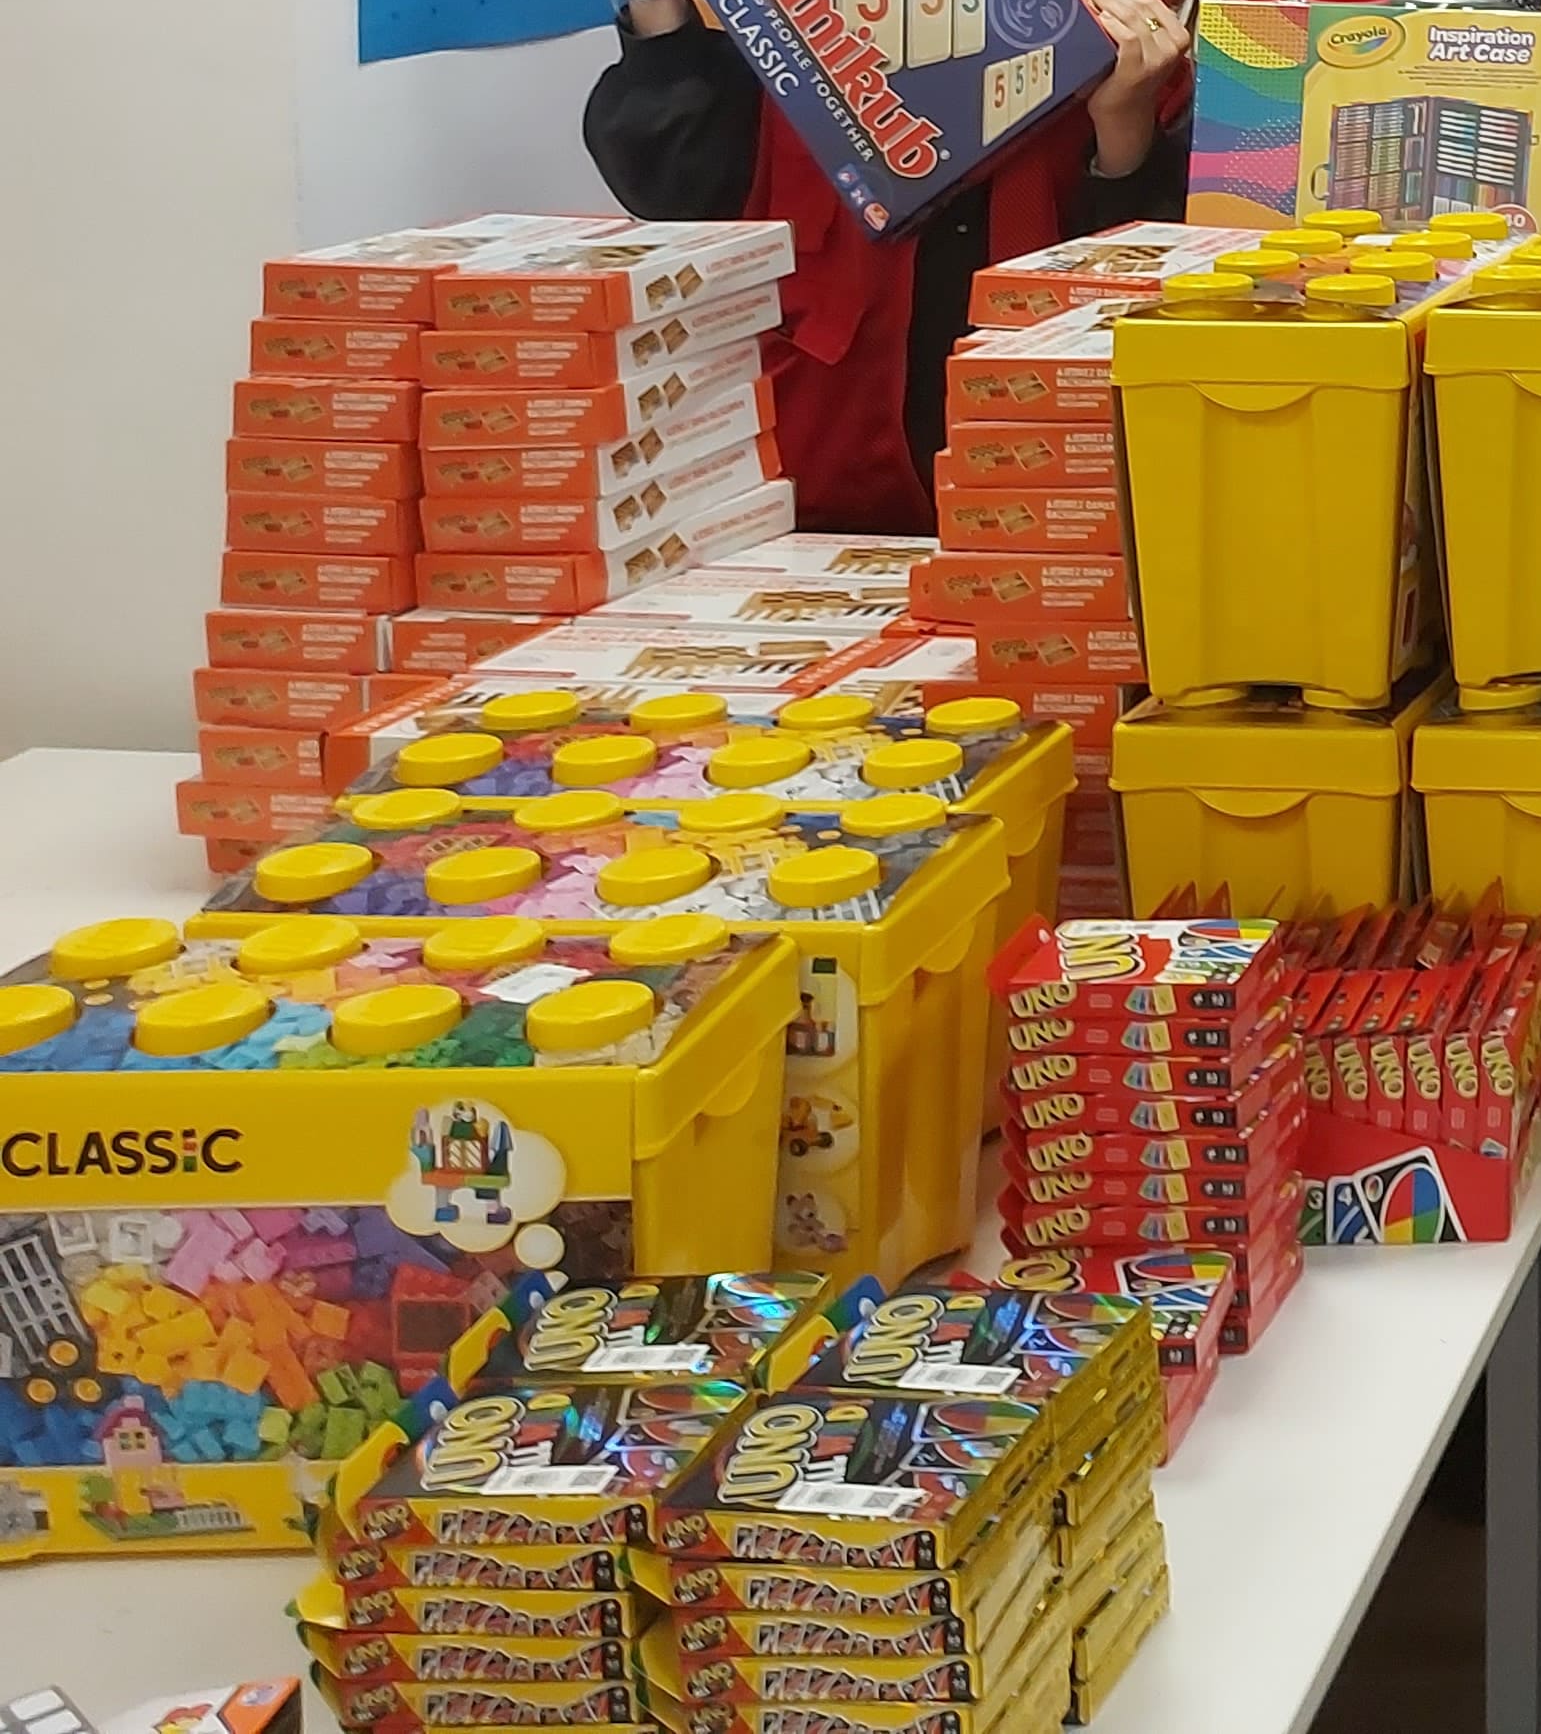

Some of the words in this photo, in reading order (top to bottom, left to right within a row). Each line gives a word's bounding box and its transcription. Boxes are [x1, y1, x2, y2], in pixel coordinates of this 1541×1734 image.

[1329, 26, 1387, 45] Crayola
[1427, 43, 1470, 62] Art
[1473, 44, 1532, 64] Case
[1428, 24, 1535, 48] Inspiration
[765, 8, 812, 70] PEOPLE
[808, 71, 875, 163] TOGETHER
[994, 72, 1006, 108] 5
[1015, 64, 1025, 95] 5
[1008, 982, 1078, 1018] UNO
[1008, 1017, 1075, 1051] UNO
[1011, 1054, 1077, 1090] UNO
[1334, 1039, 1368, 1101] UNO
[1370, 1035, 1404, 1100] UNO
[1407, 1035, 1441, 1100] UNO
[1445, 1033, 1478, 1099] UNO
[1481, 1032, 1515, 1097] UNO
[1022, 1093, 1085, 1130] UNO
[2, 1128, 243, 1177] CLASSIC
[1027, 1135, 1094, 1172] UNO
[1027, 1170, 1093, 1204] UNO
[1306, 1185, 1325, 1209] 3
[1337, 1184, 1354, 1206] 4
[1024, 1207, 1091, 1247] UNO
[523, 1287, 620, 1372] UNO
[842, 1294, 945, 1384] UNO
[420, 1395, 527, 1492] UNO
[716, 1402, 824, 1504] UNO
[662, 1514, 707, 1541] UNO
[674, 1567, 720, 1596] UNO
[681, 1616, 726, 1644] UNO
